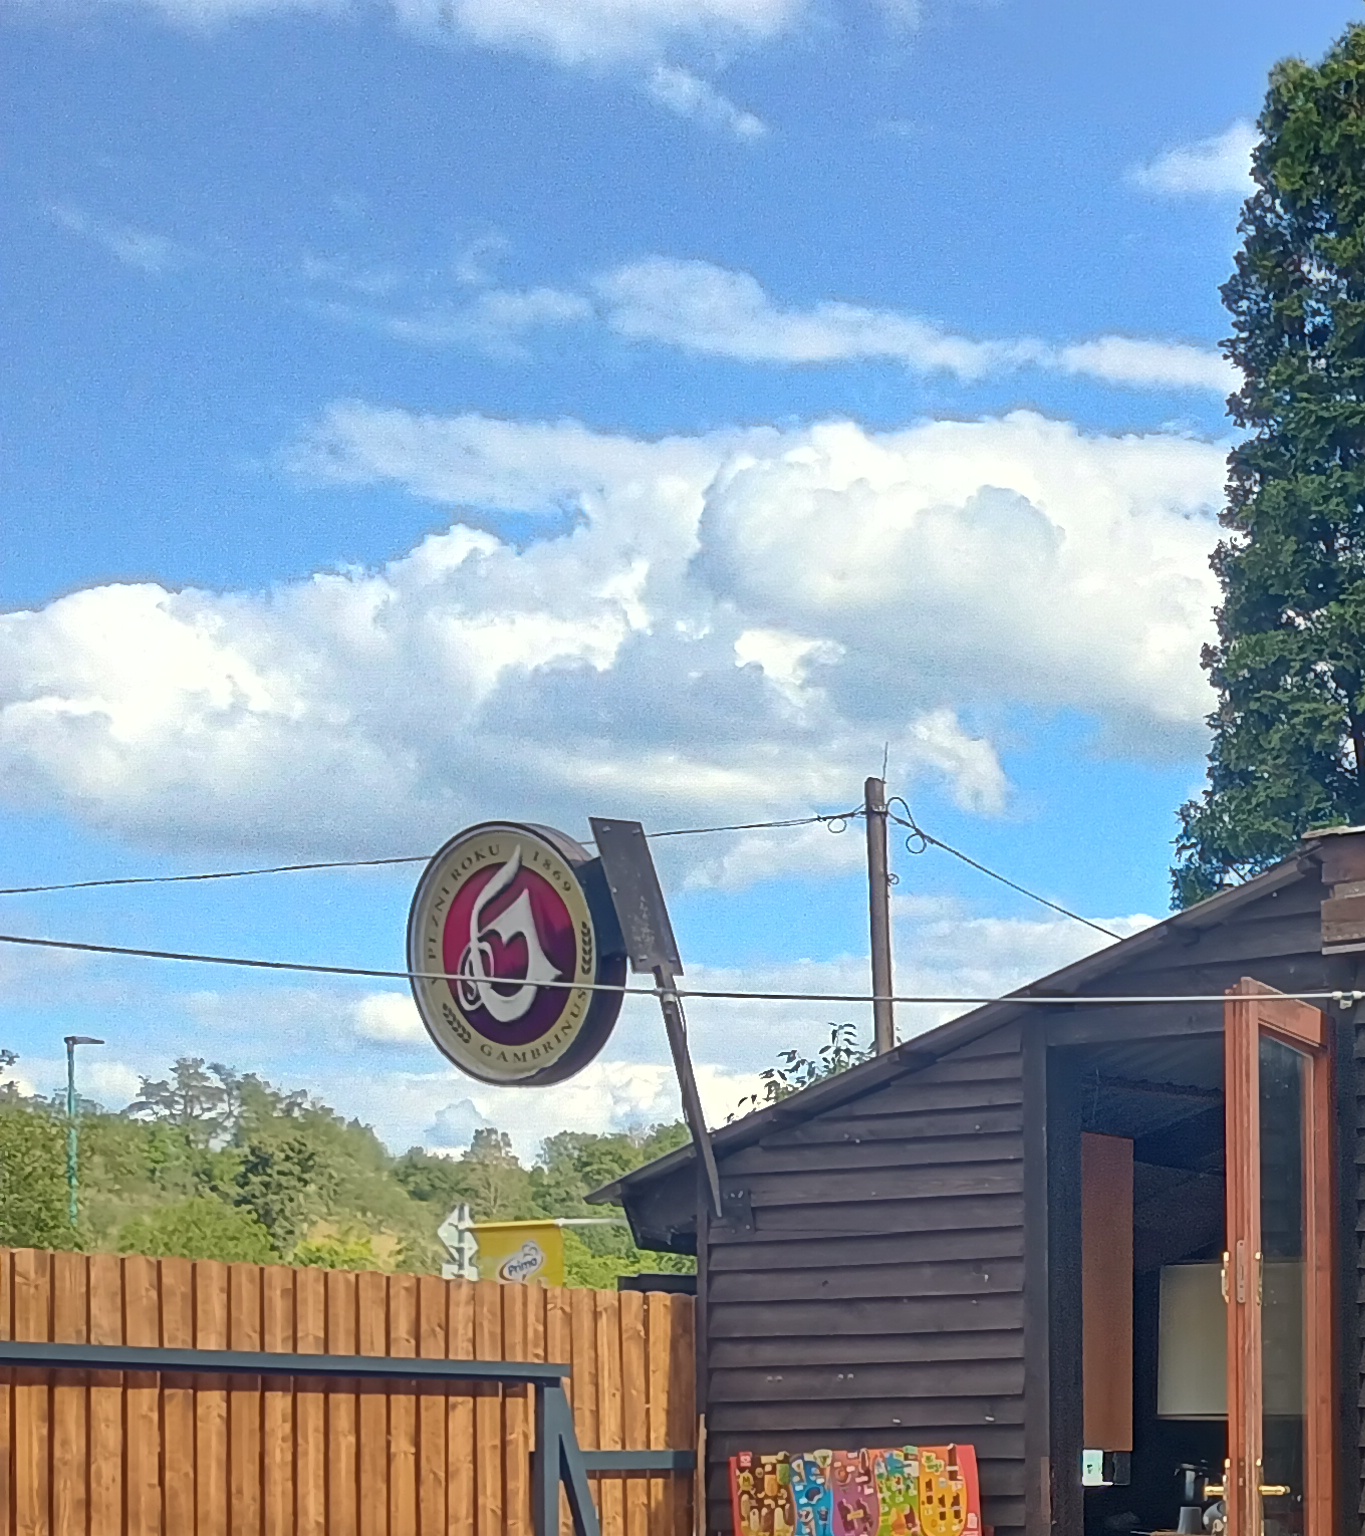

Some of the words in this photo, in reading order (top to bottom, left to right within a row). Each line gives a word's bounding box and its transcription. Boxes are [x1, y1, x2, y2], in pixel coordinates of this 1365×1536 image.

[452, 843, 502, 882] ROKU
[531, 851, 573, 893] 1869
[479, 988, 589, 1065] GAMBRINUS
[508, 1257, 538, 1276] Primo
